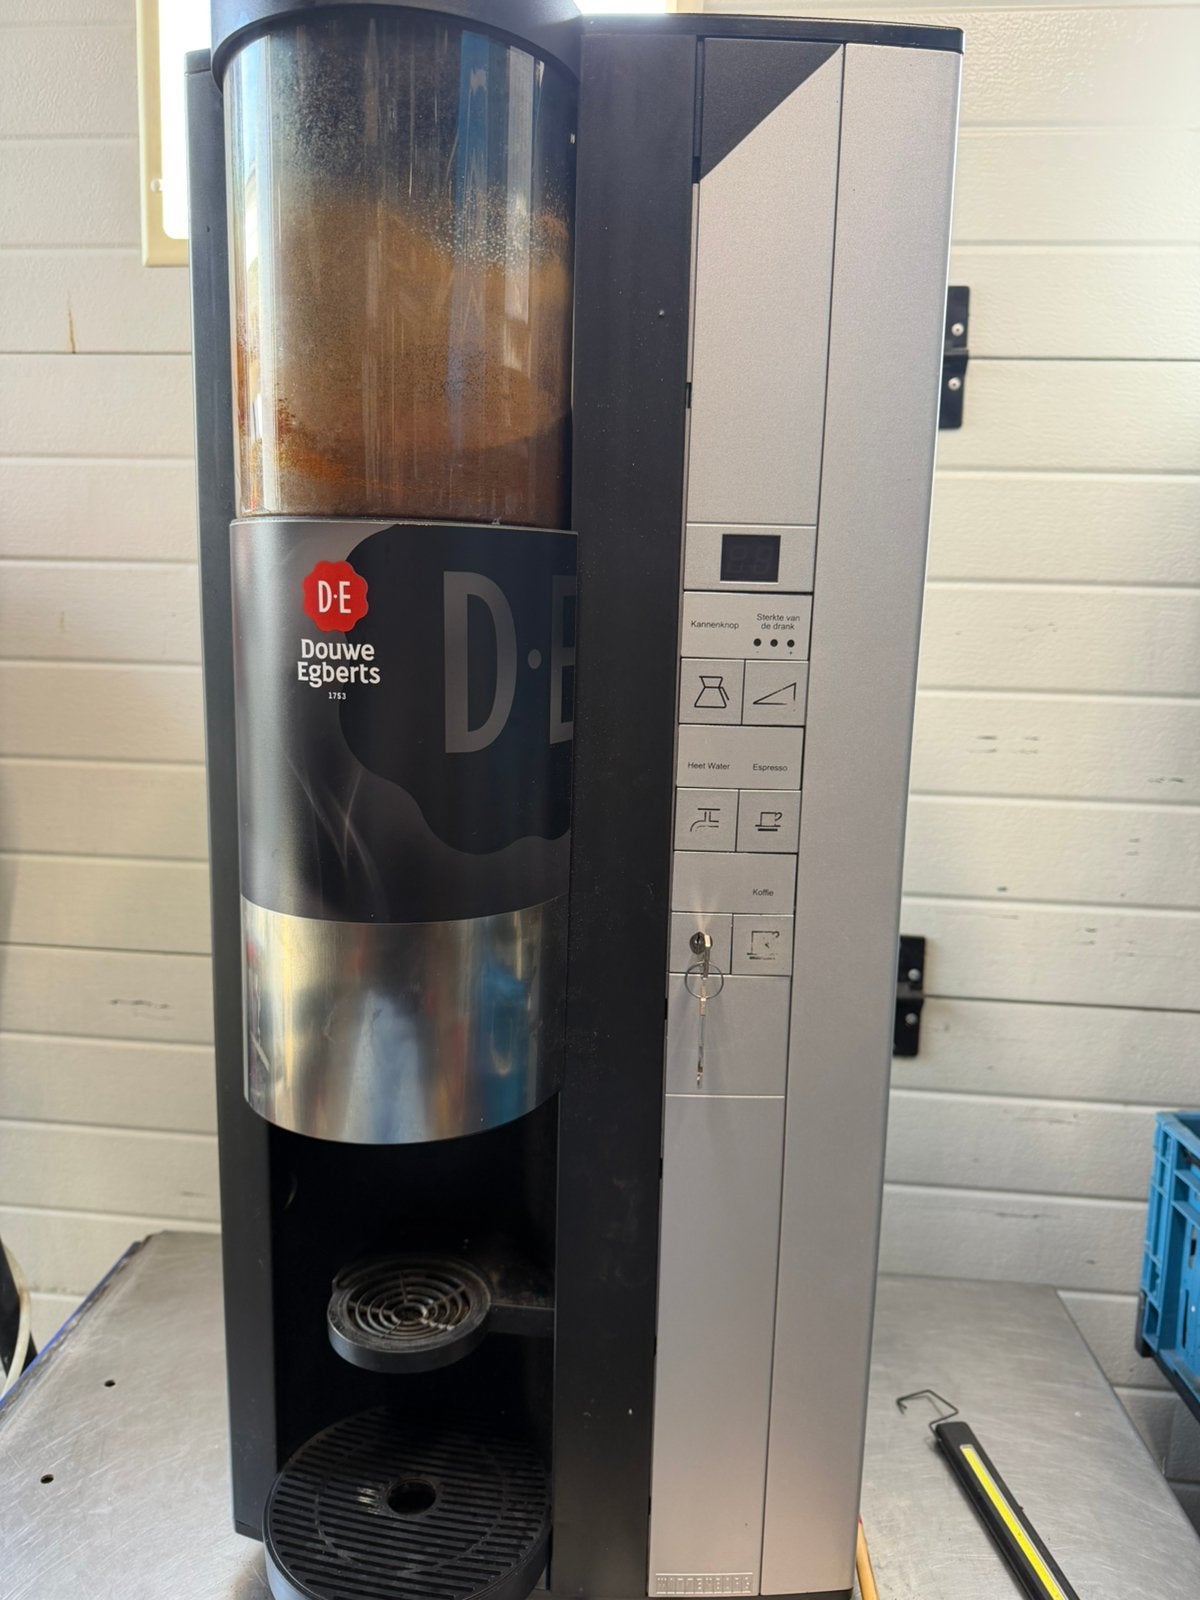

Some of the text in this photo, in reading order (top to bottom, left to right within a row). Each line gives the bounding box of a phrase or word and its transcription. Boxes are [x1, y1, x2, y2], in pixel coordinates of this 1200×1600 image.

[756, 613, 784, 622] Sterkte
[691, 620, 740, 630] Kannenknop
[760, 622, 795, 630] de drank
[301, 638, 375, 662] Douwe
[297, 661, 381, 688] Egberts
[328, 691, 347, 700] 1753
[752, 763, 788, 772] Espresso
[752, 888, 774, 897] Koffie
